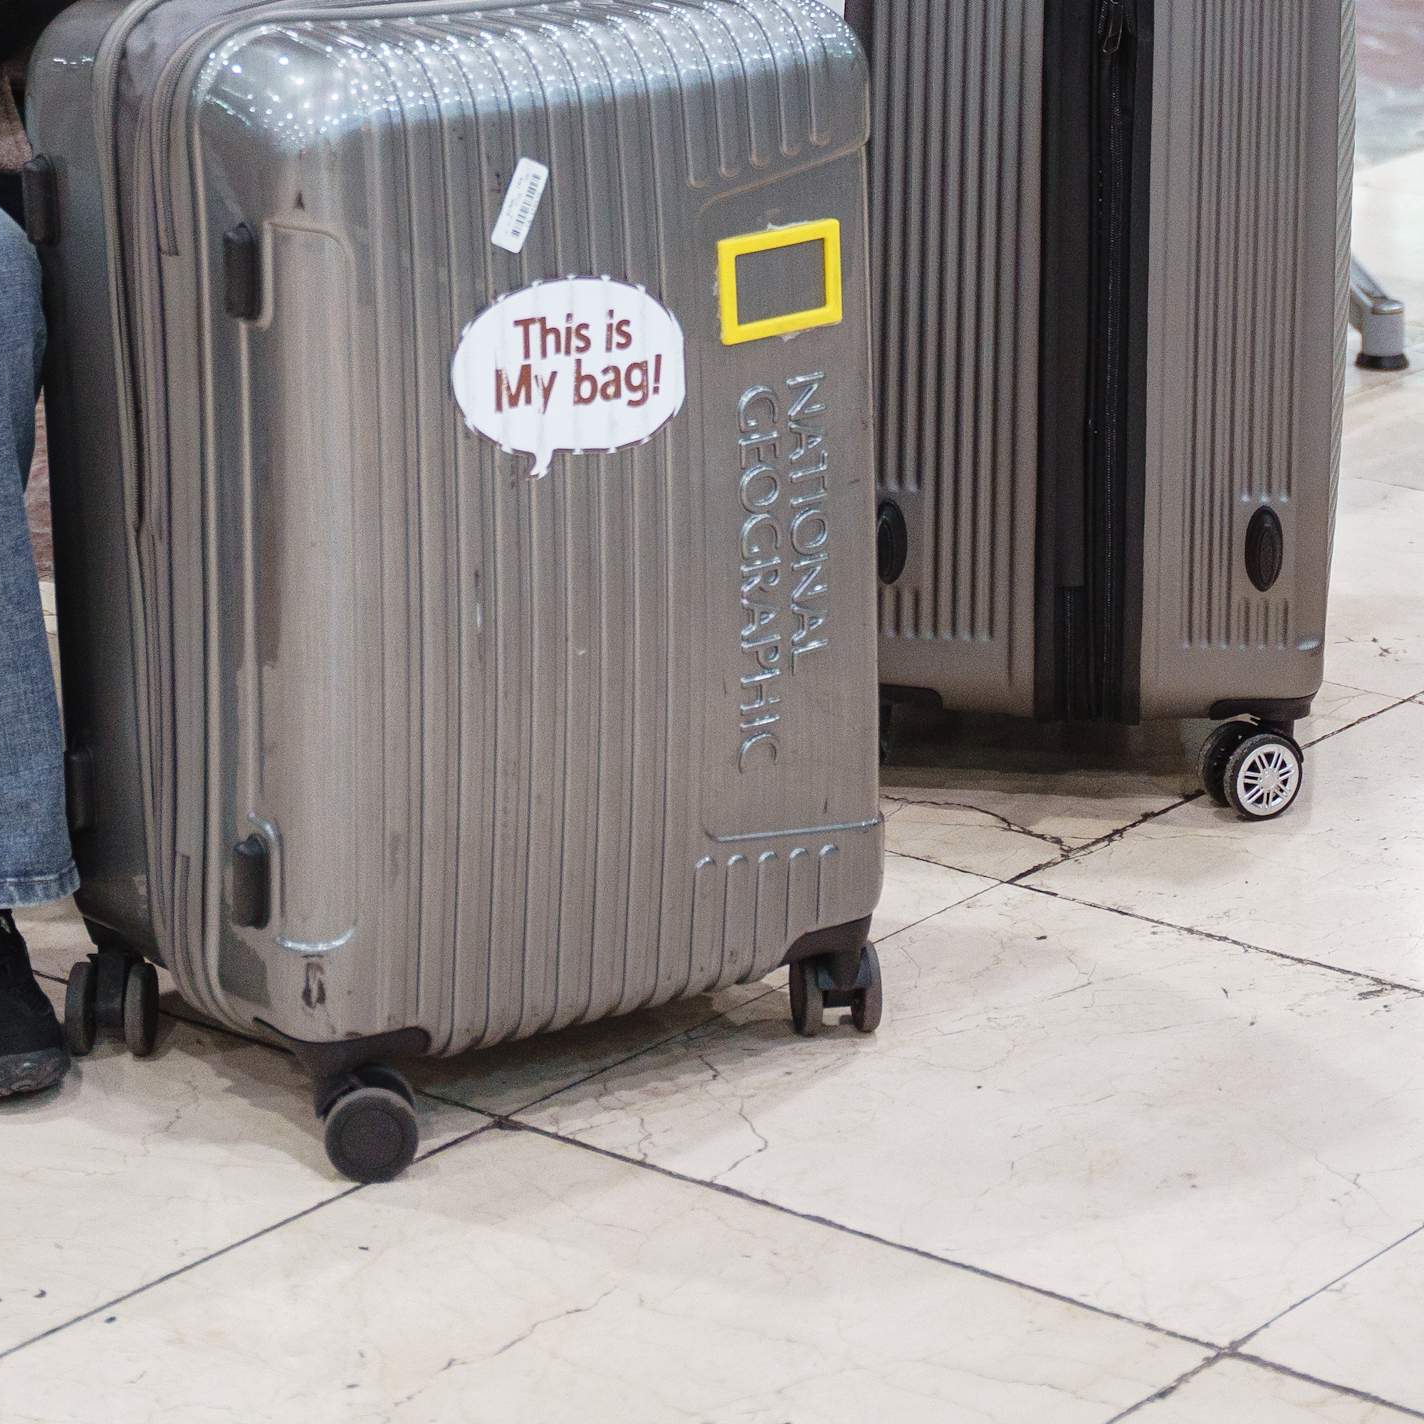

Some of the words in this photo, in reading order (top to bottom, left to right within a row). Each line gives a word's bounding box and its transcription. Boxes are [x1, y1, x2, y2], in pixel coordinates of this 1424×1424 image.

[494, 362, 558, 415] My
[573, 353, 663, 407] bag!
[512, 312, 592, 360] This
[605, 308, 633, 353] is
[736, 383, 781, 775] GEOGRAPHIC
[786, 370, 829, 676] NATIONAL
